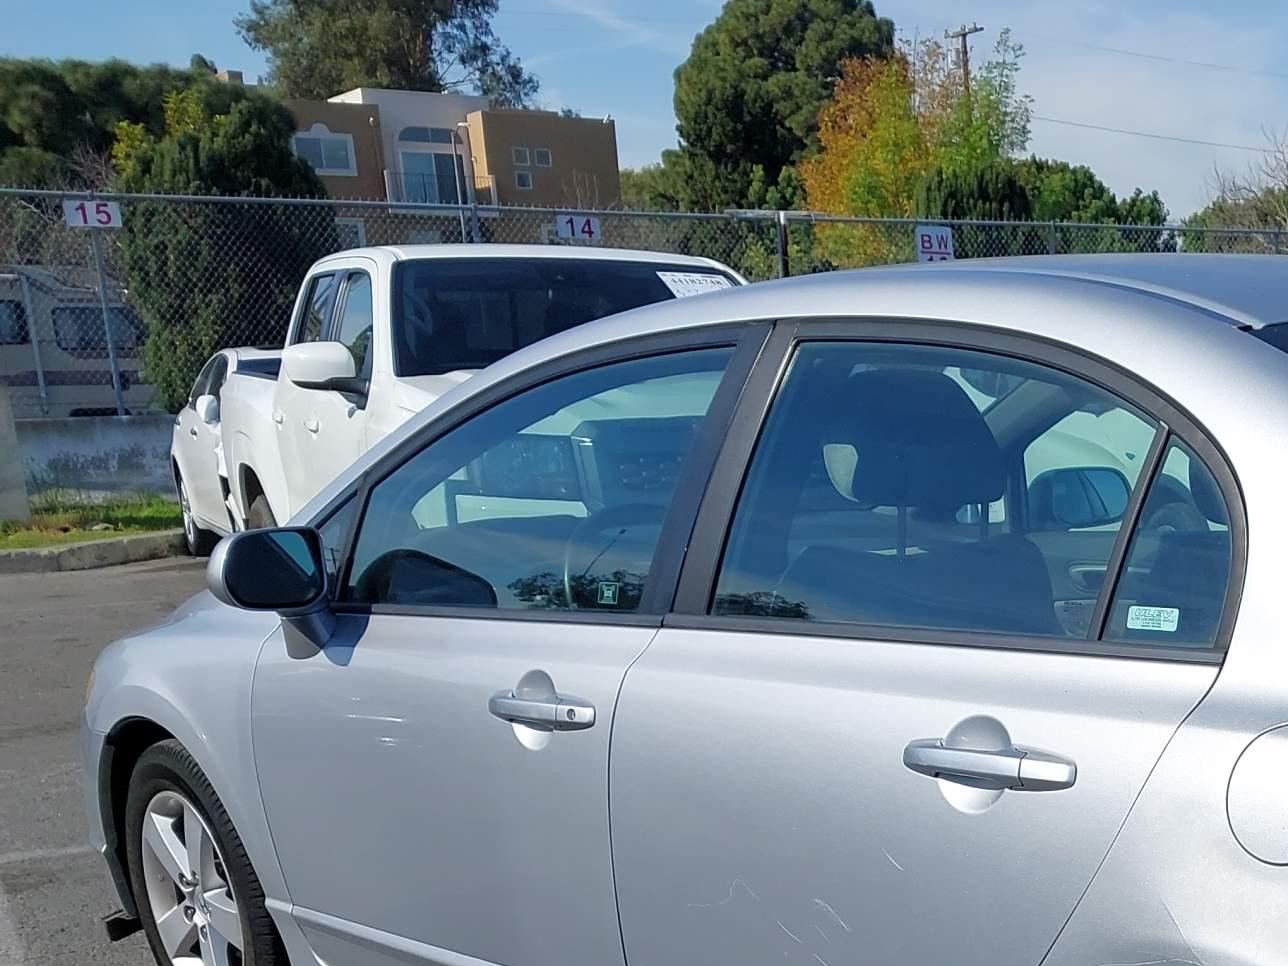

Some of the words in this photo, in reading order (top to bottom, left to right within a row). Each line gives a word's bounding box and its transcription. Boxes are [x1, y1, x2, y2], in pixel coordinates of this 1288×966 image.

[75, 202, 112, 225] 15
[565, 217, 594, 238] 14
[920, 233, 948, 250] BW
[1135, 608, 1174, 618] ULEV
